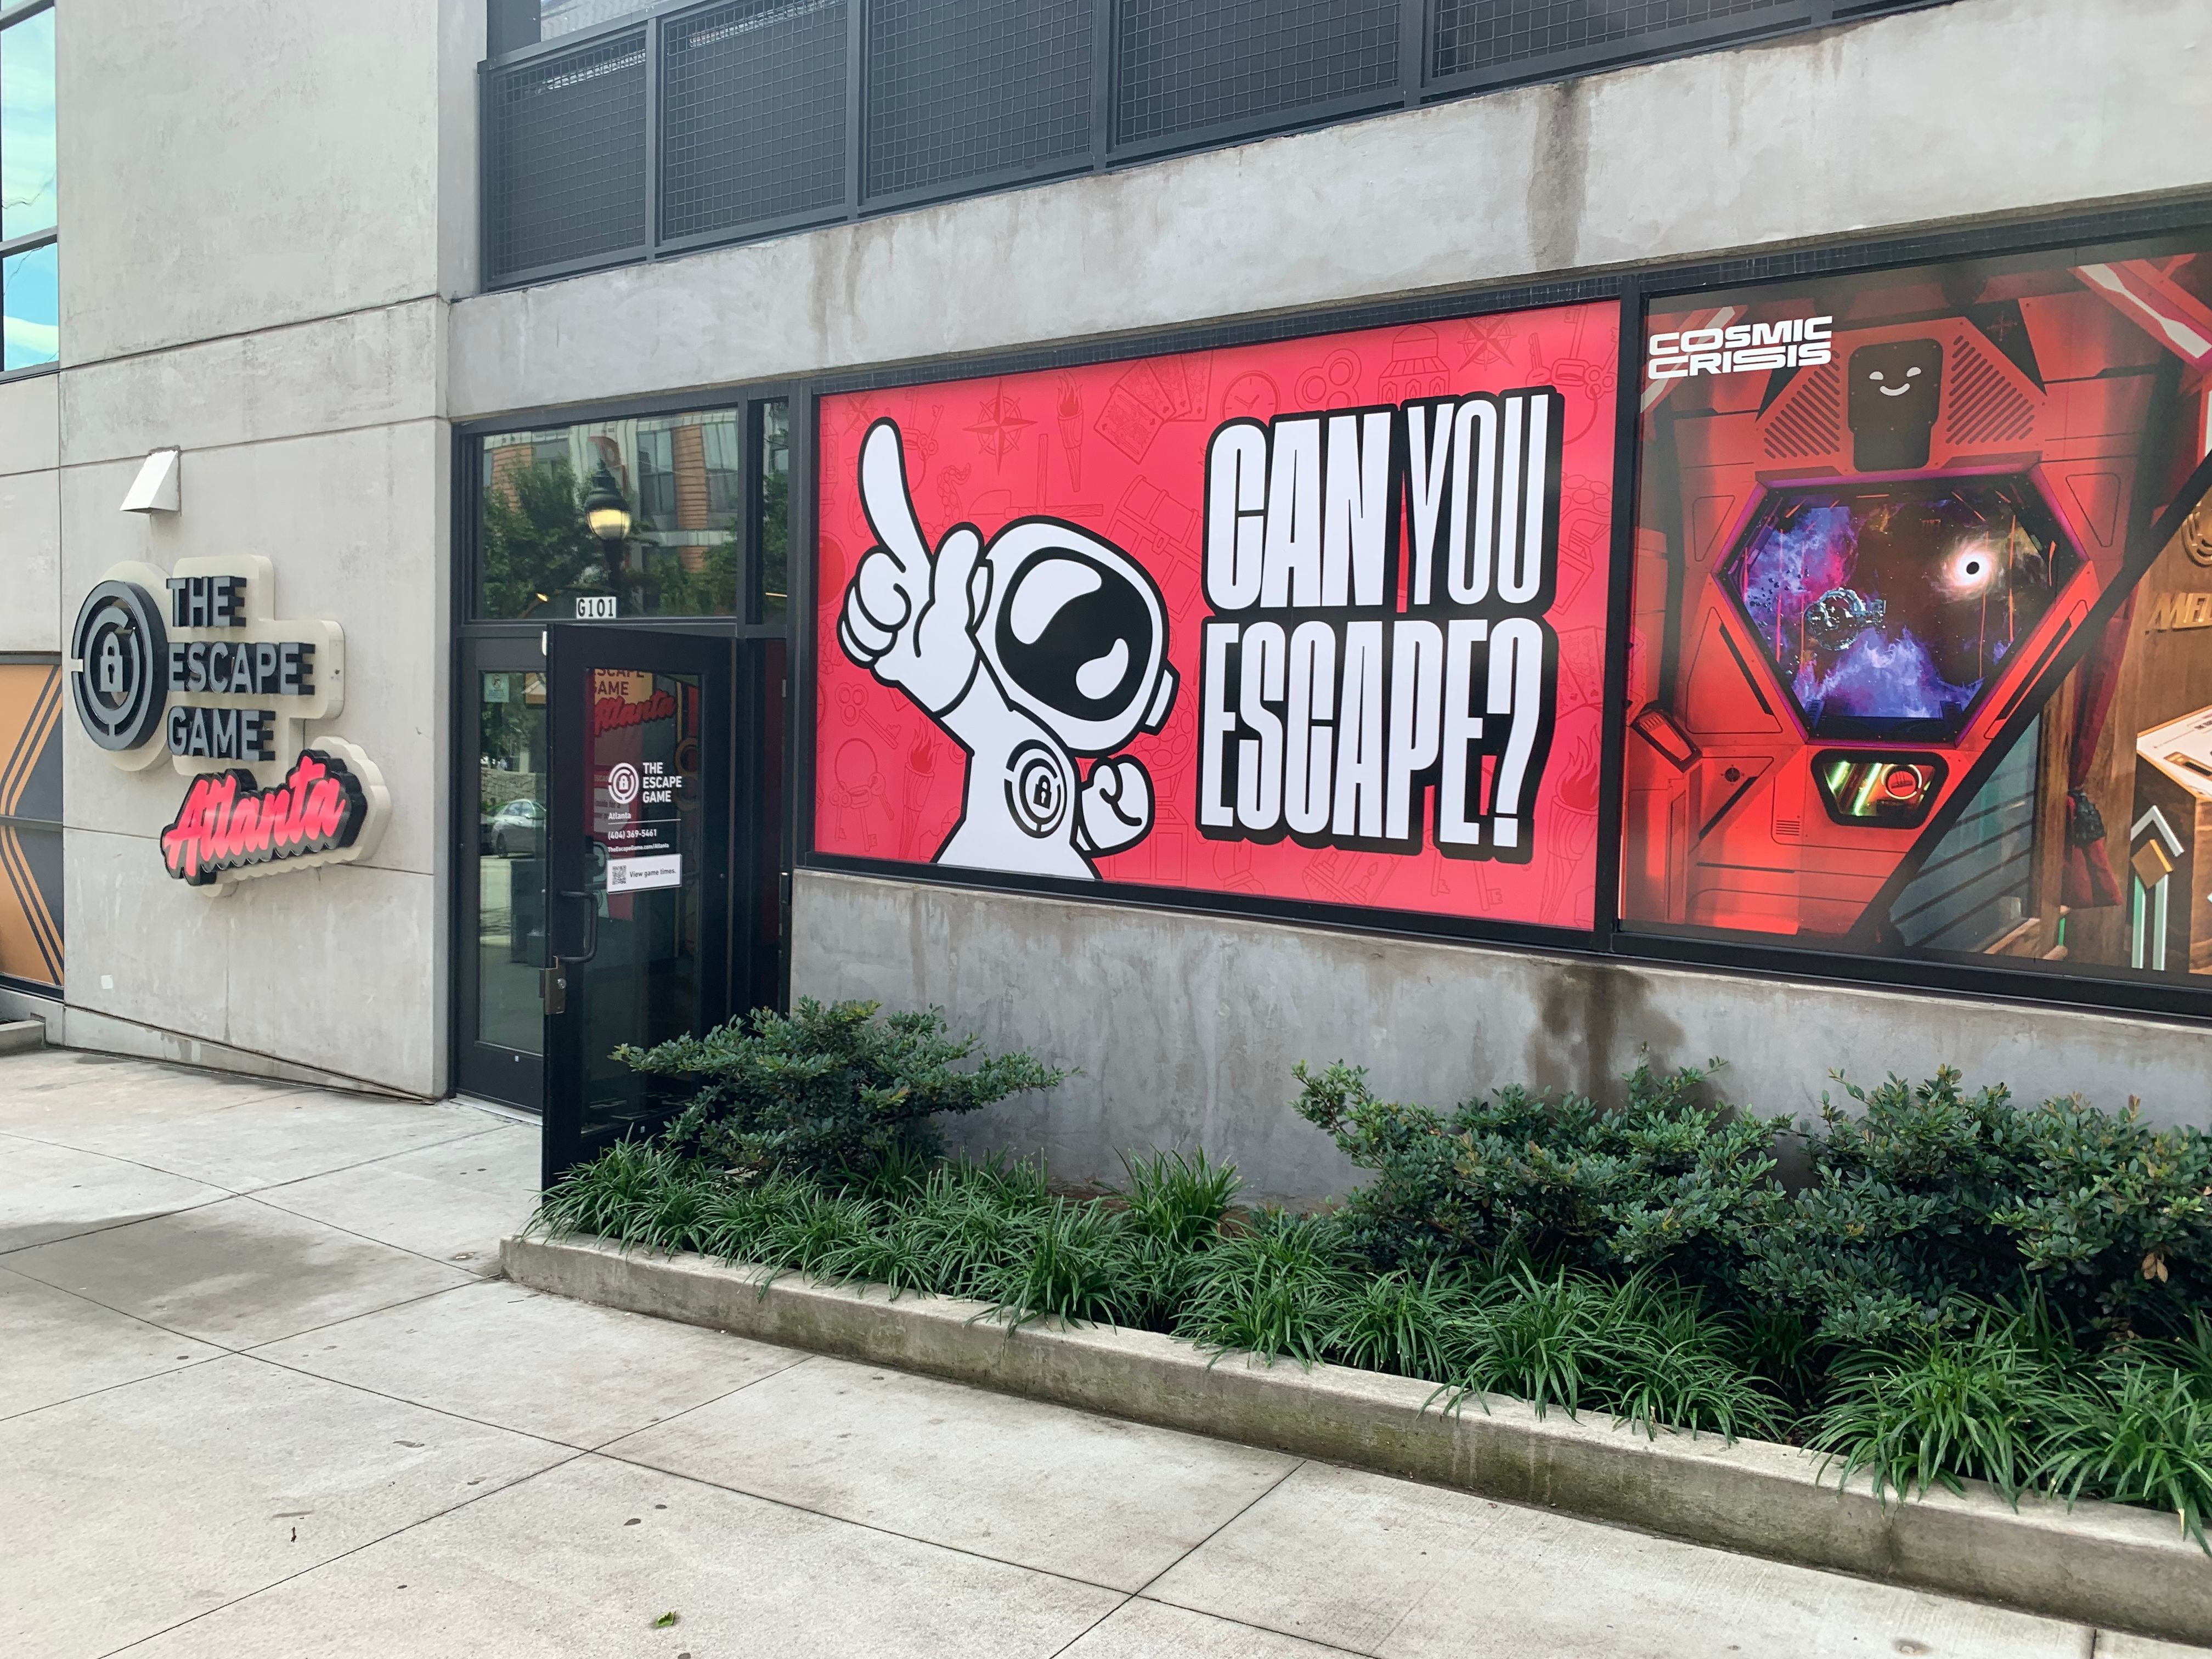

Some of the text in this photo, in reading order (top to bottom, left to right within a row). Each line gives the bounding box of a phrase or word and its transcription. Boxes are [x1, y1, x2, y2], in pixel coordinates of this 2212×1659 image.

[1649, 316, 1832, 356] COSMIC
[1648, 341, 1831, 379] CRISIS
[1206, 393, 1549, 610] CAN YOU
[166, 576, 246, 627] THE
[577, 598, 614, 617] G101
[168, 641, 315, 695] ESCAPE
[167, 706, 275, 761] GAME
[1200, 618, 1543, 848] ESCAPE?
[642, 762, 663, 775] THE
[642, 776, 683, 789] ESCAPE
[163, 754, 347, 878] Atlanta
[608, 812, 631, 820] Atlanta
[642, 790, 672, 804] GAME
[608, 829, 657, 840] (404) 369-5461
